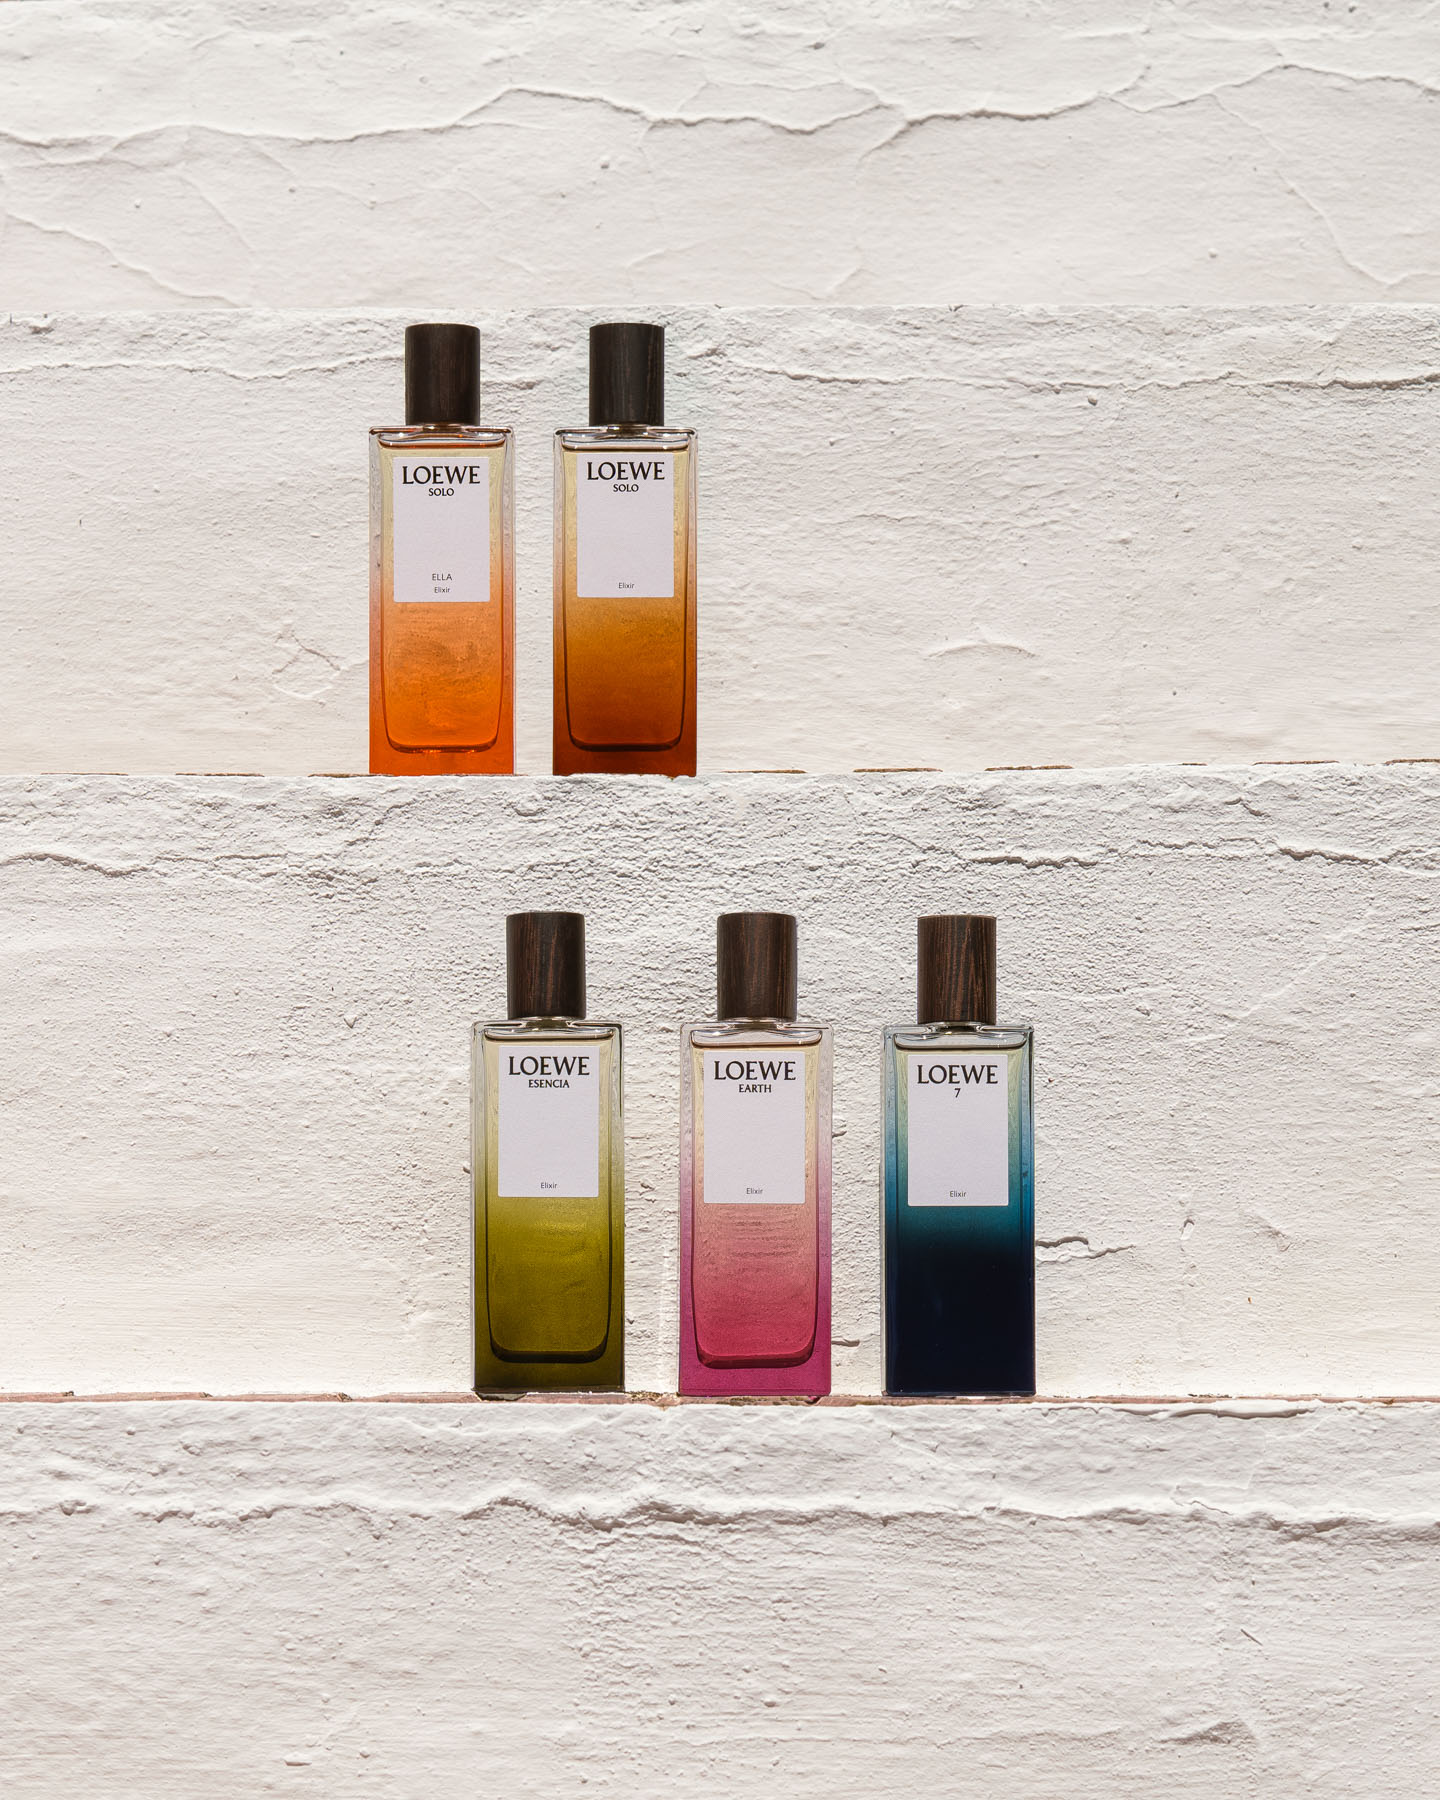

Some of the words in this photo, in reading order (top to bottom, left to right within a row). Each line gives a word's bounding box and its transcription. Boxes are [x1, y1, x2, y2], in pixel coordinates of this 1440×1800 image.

[401, 465, 481, 485] LOEWE
[586, 461, 666, 481] LOEWE
[428, 487, 455, 497] SOLO
[612, 483, 640, 493] SOLO
[431, 573, 453, 581] ELLA
[434, 586, 451, 594] Elixir
[508, 1055, 591, 1076] LOEWE
[713, 1060, 797, 1081] LOEWE
[916, 1064, 999, 1085] LOEWE
[528, 1078, 570, 1089] ESENCIA
[738, 1083, 772, 1094] EARTH
[953, 1087, 962, 1099] 7
[540, 1181, 558, 1189] Elixir
[746, 1187, 764, 1195] Elixir
[949, 1190, 967, 1198] Elixir
